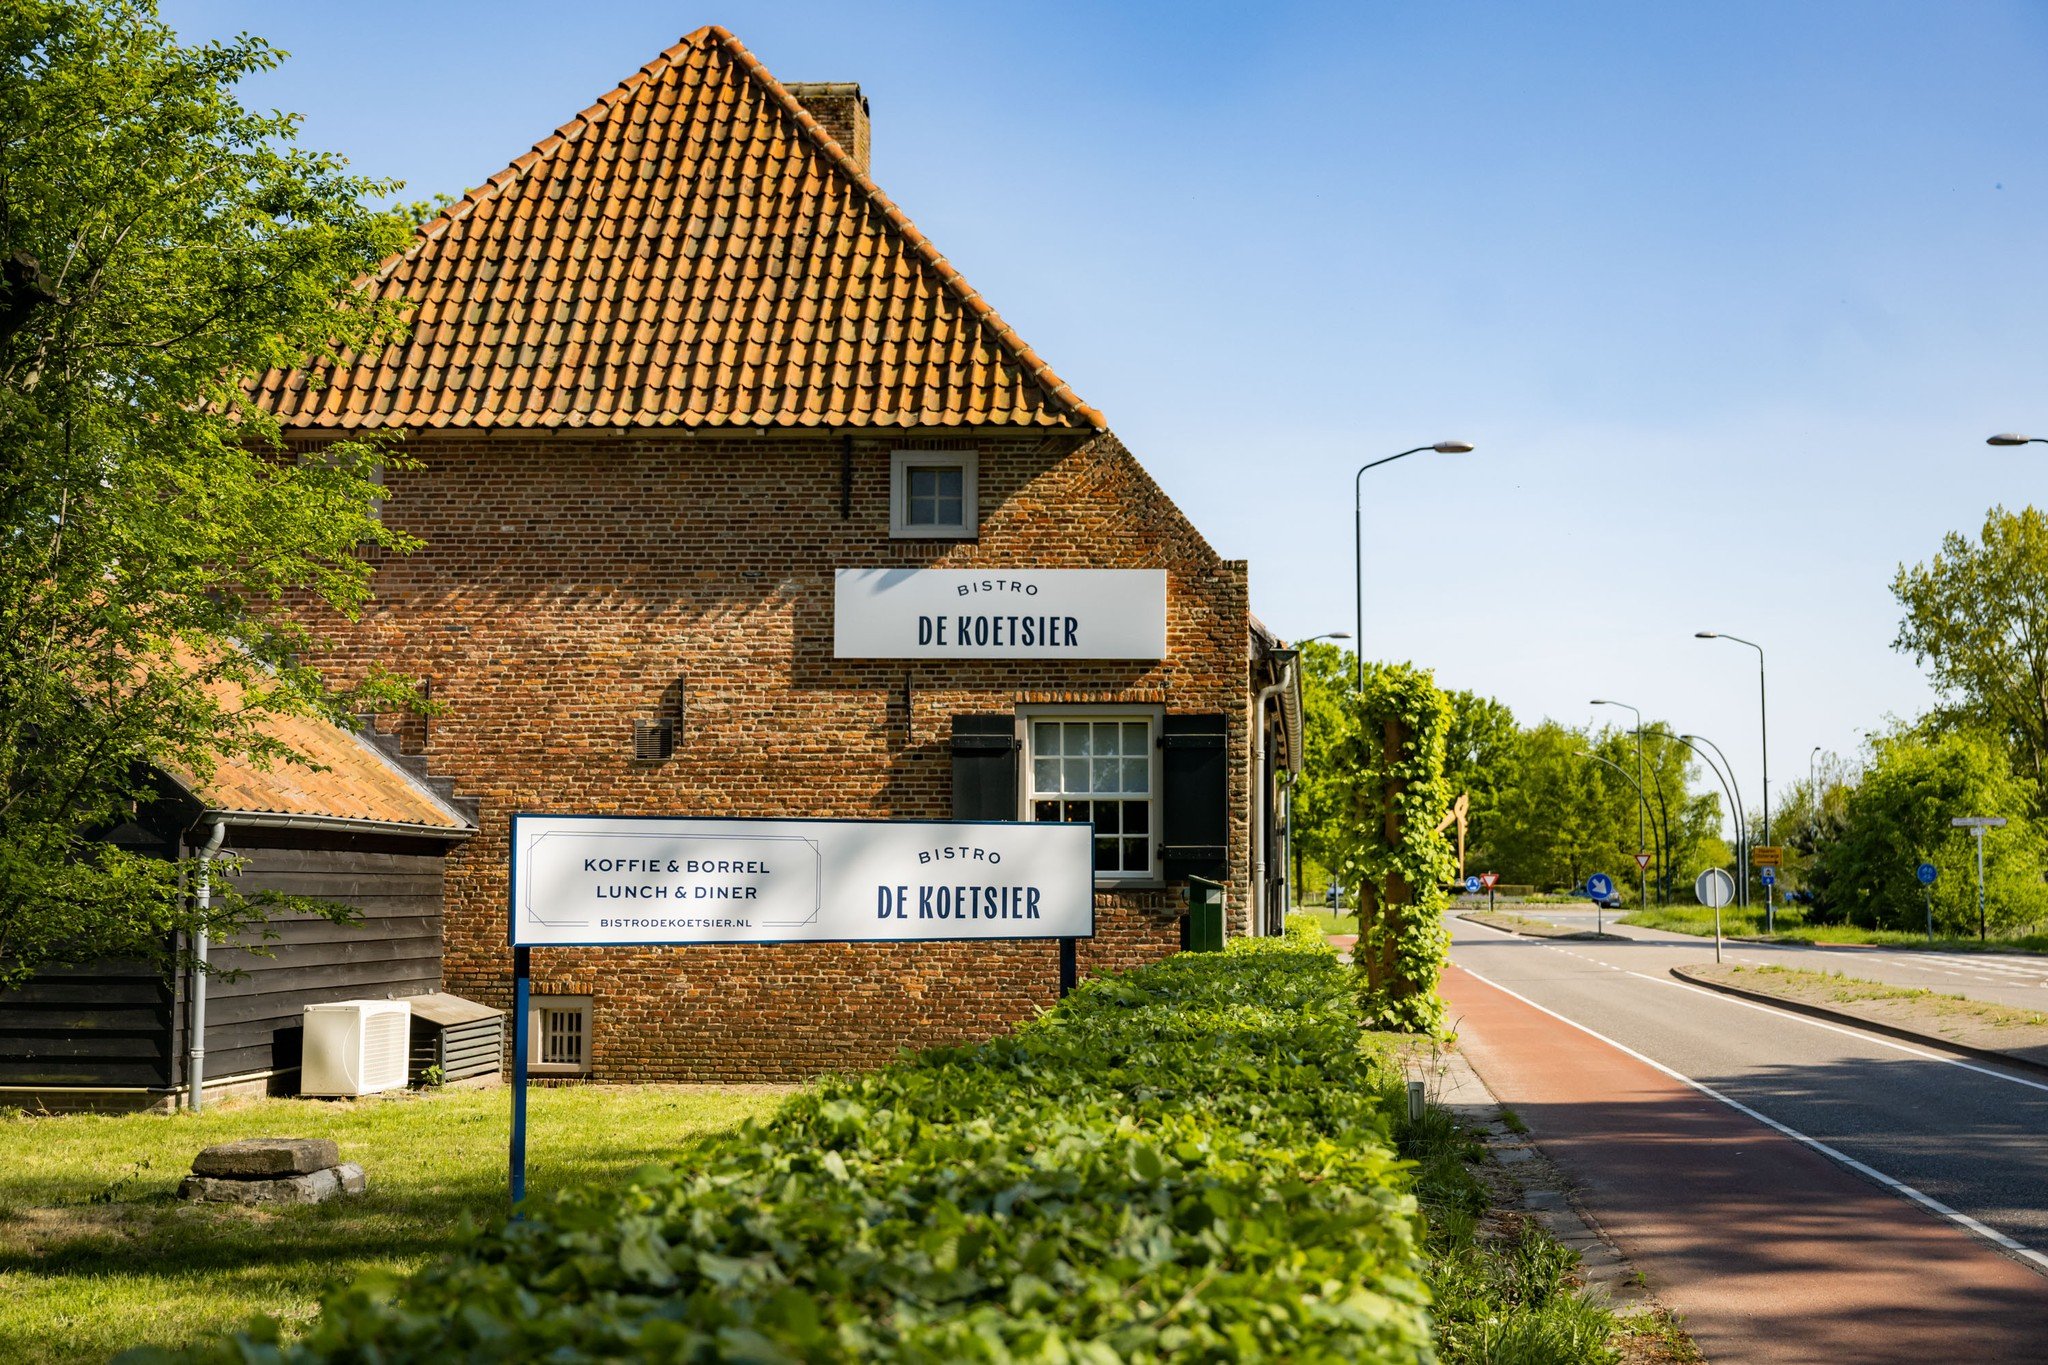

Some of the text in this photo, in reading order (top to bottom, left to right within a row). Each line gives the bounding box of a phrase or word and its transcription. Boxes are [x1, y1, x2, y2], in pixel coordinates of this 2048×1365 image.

[956, 580, 1038, 597] BISTRO
[918, 615, 1079, 647] DE KOETSIER
[918, 846, 1001, 865] BISTRO
[584, 858, 771, 875] KOFFIE & BORREL
[596, 885, 758, 900] LUNCH & DINER
[877, 885, 1041, 920] DE KOETSIER
[600, 918, 752, 928] BISTRODEKOETSIER.NL
